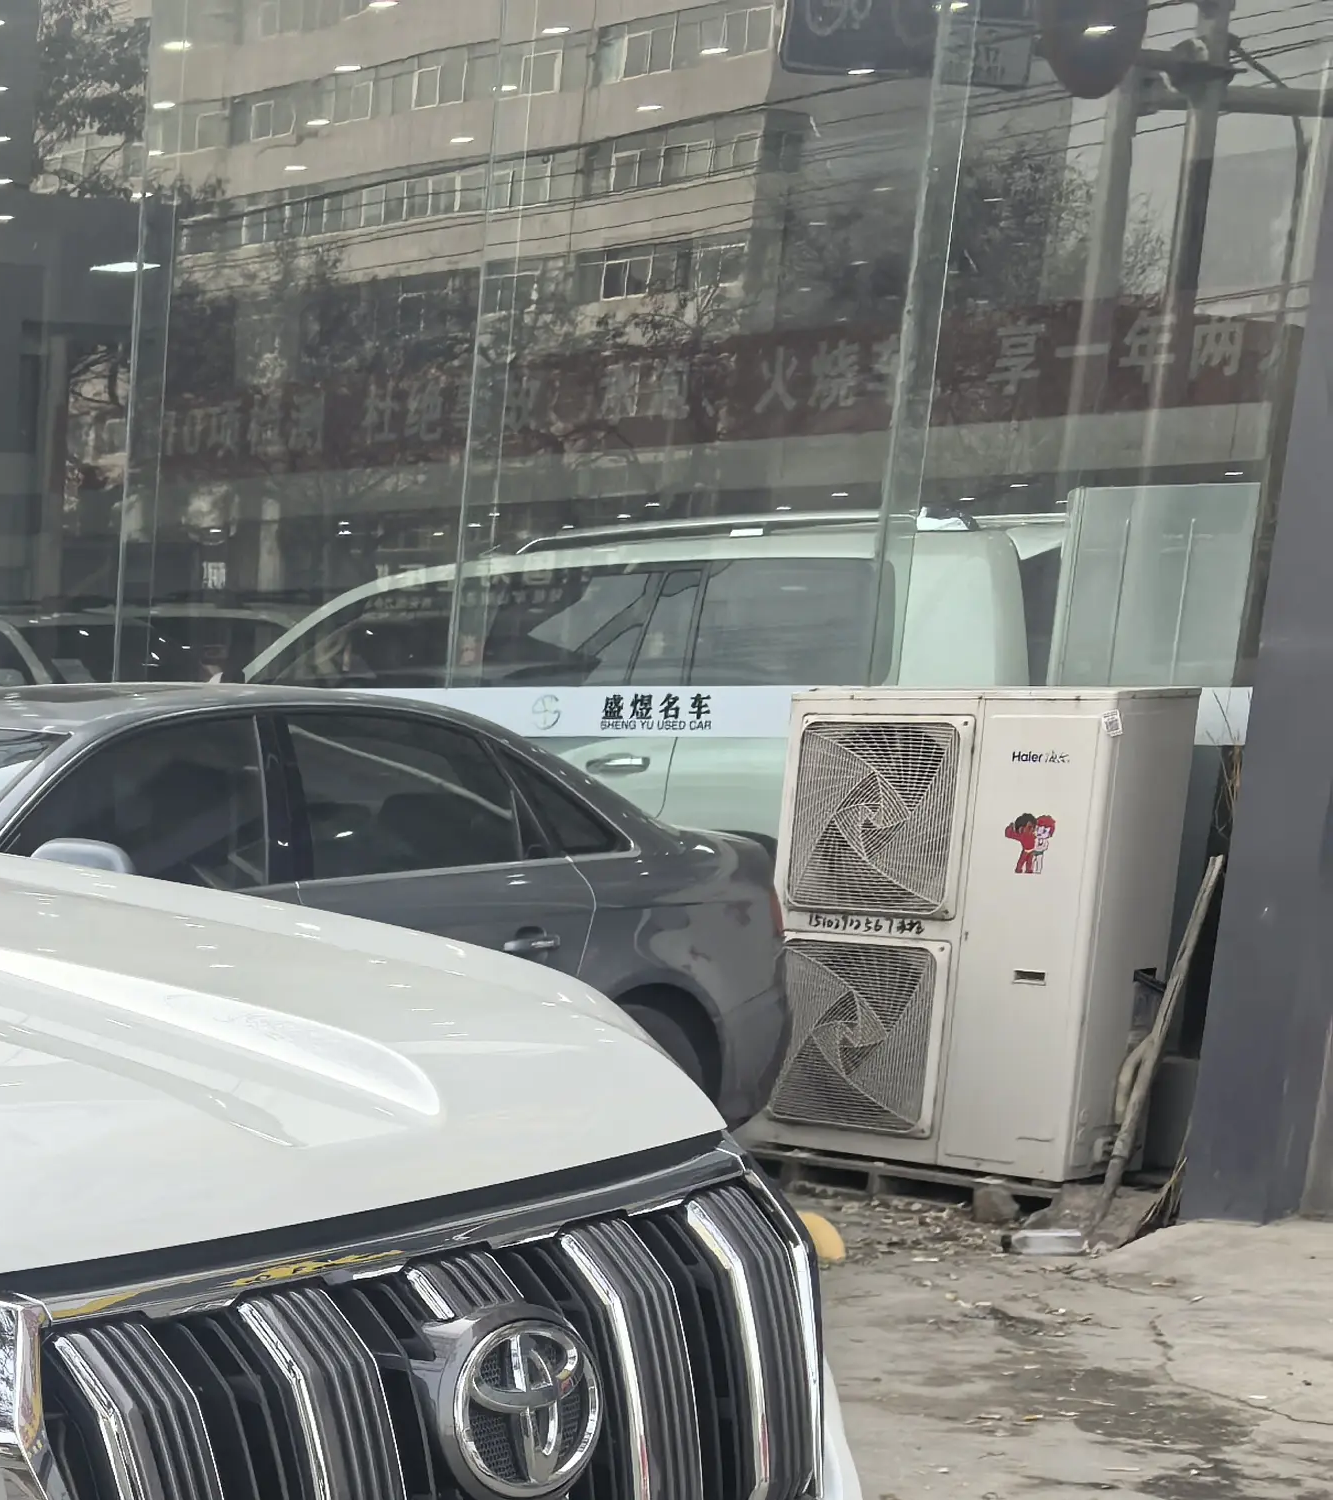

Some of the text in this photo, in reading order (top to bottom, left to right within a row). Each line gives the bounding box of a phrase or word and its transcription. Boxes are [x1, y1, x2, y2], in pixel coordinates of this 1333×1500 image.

[601, 693, 713, 721] 盛煜名车
[600, 720, 713, 731] SHENG YU USED CAR
[1011, 750, 1044, 763] Haier
